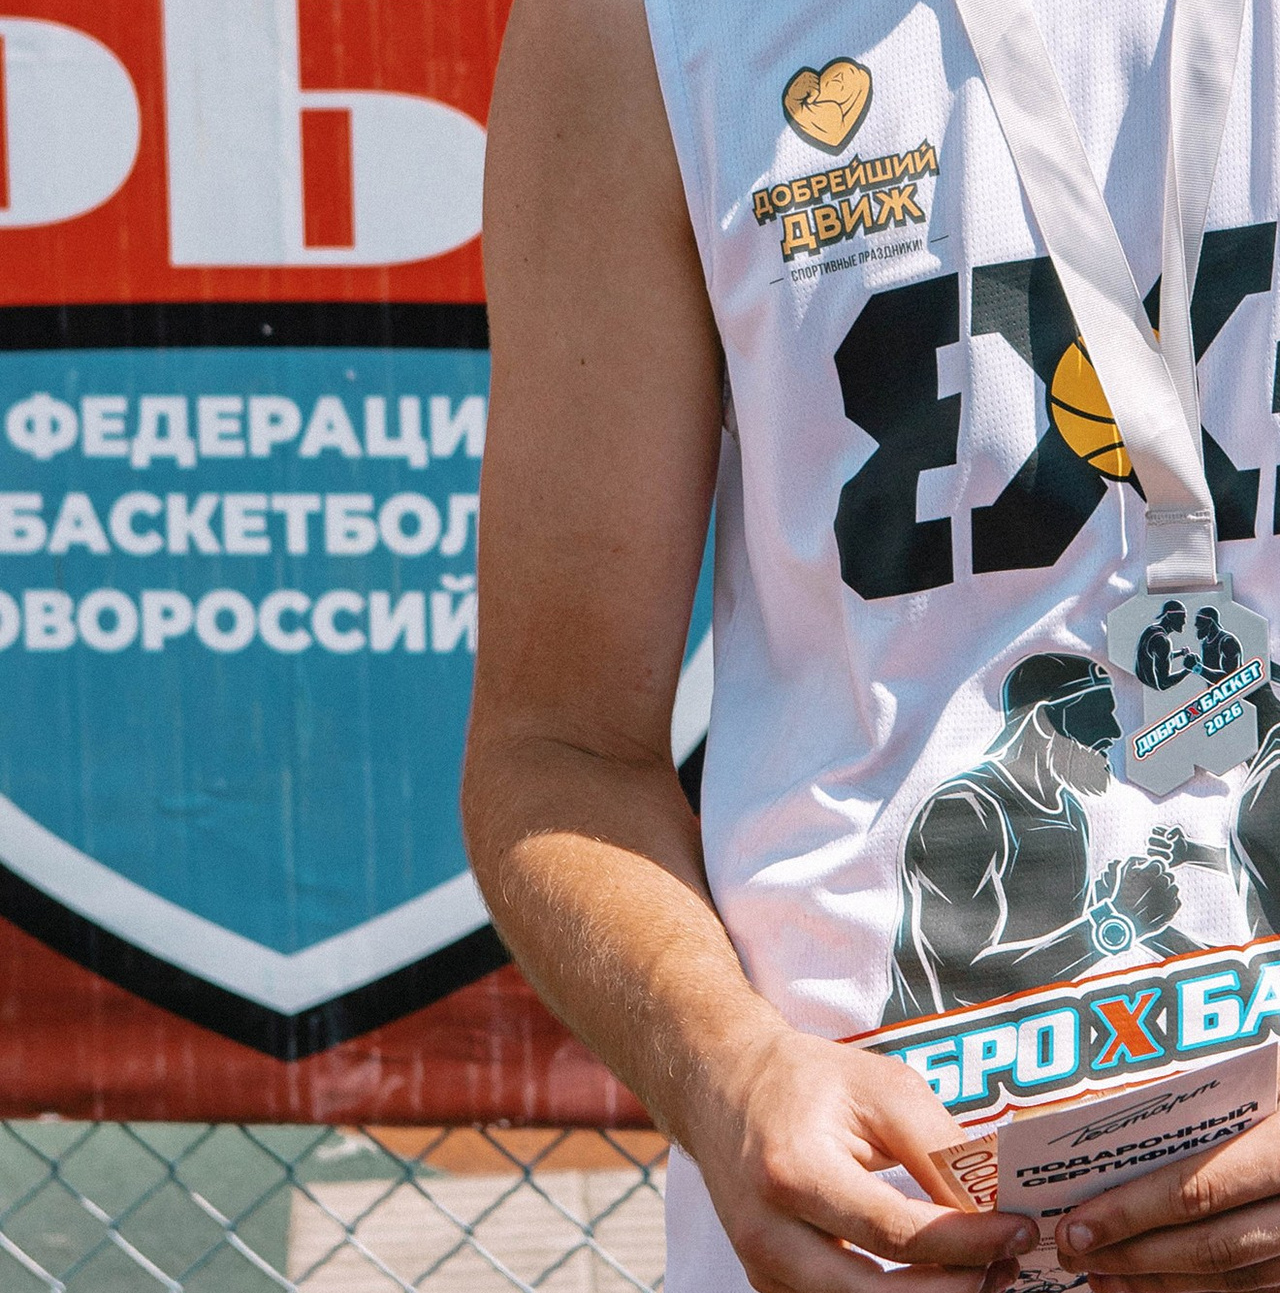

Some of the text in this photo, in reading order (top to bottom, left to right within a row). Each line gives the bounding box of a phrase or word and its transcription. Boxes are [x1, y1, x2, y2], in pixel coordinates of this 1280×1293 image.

[752, 139, 940, 225] ДОБРЕЙШИЙ
[780, 183, 927, 262] ДВИЖ
[790, 254, 858, 283] СПОРТИВНЫЕ
[1136, 711, 1189, 757] ДОБРО
[1200, 661, 1261, 712] БАСКЕТ
[1204, 700, 1244, 737] 2026
[886, 1007, 1080, 1108] БРО
[1016, 1100, 1259, 1179] ПОДАРОЧНЫЙ
[1021, 1118, 1253, 1188] СЕРТИФИКАТ
